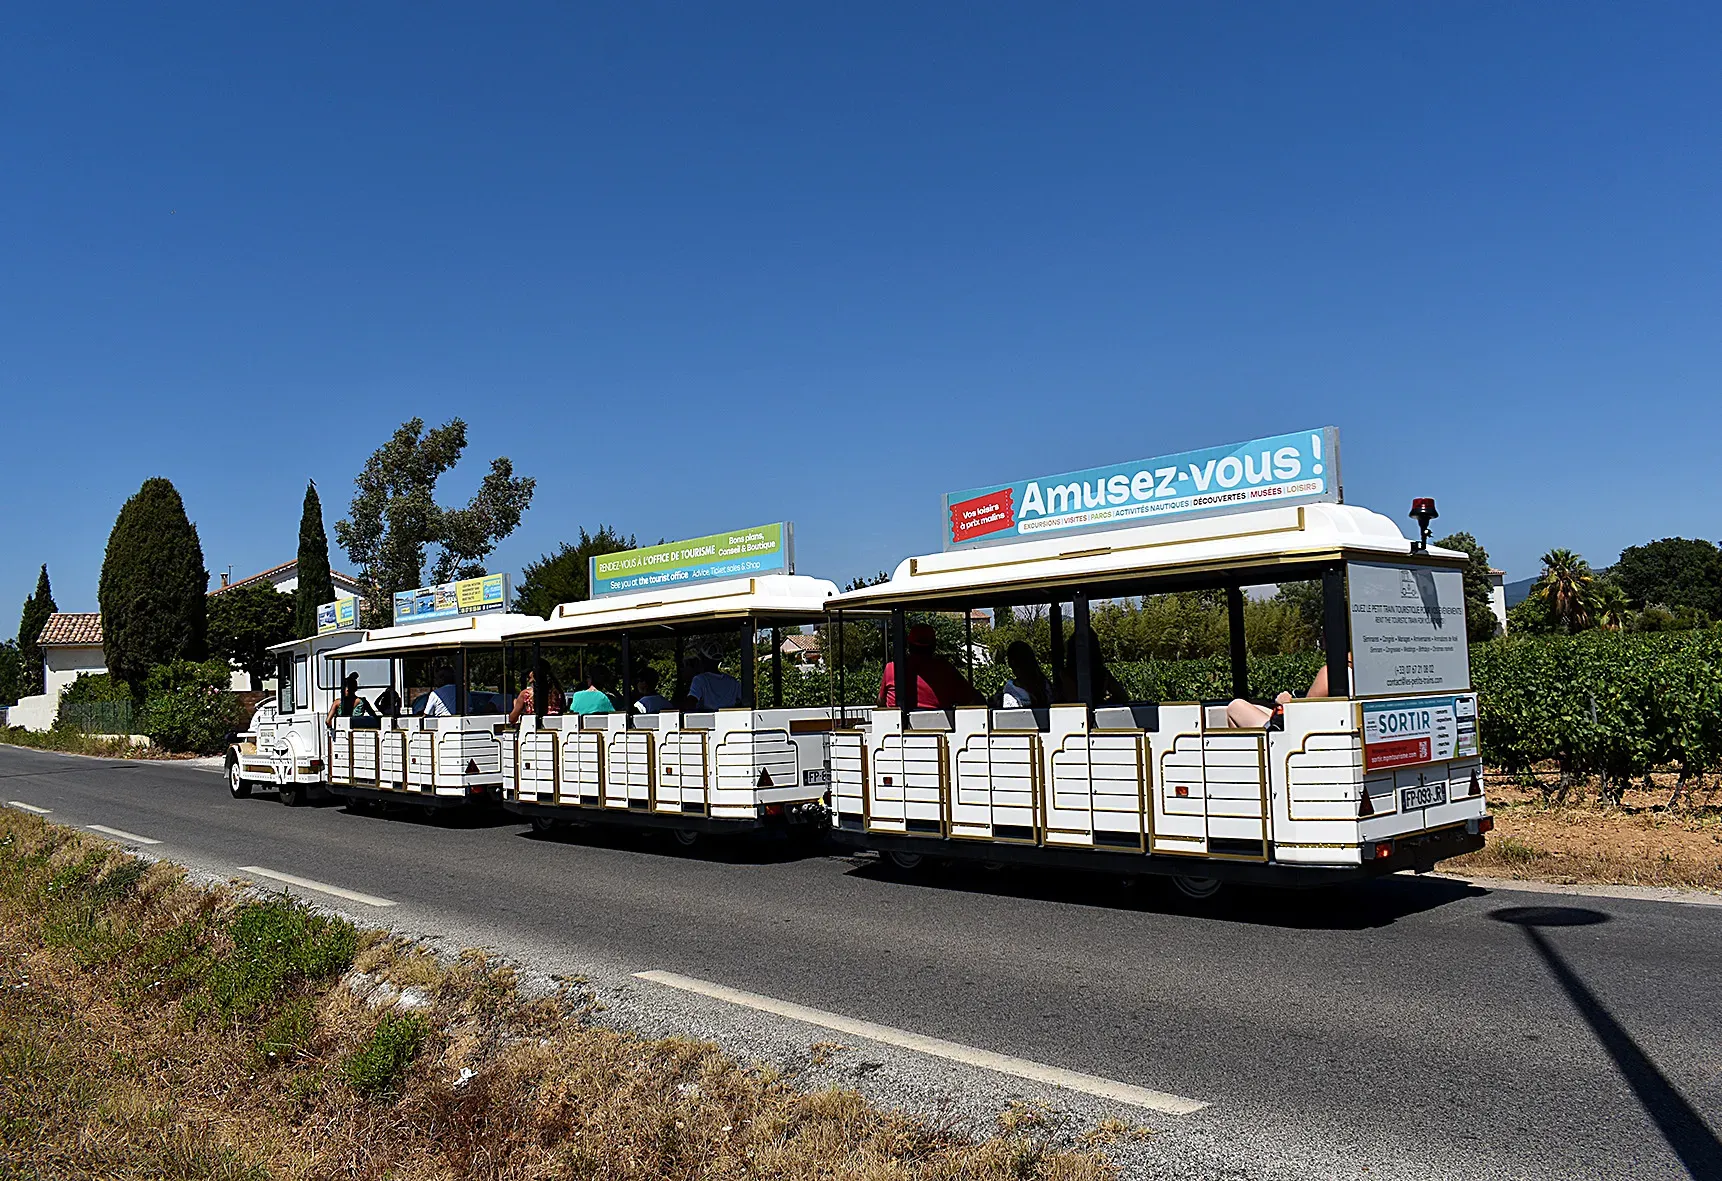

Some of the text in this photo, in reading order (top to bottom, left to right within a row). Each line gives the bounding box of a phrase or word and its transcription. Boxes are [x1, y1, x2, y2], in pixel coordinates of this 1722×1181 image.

[1018, 434, 1323, 518] Amusez-vous !
[962, 503, 1000, 520] Vos loisirs
[1023, 482, 1317, 530] EXCURSIONS VISITES PARCS ACTIVITÉS NAUTIQUES DÉCOUVERTES MUSÉES LOISIRS
[960, 511, 1006, 530] à prix malins
[718, 540, 776, 556] Conseil & Boutique
[728, 532, 764, 545] Bons plans,
[599, 557, 637, 573] RENDEZ-VOUS
[643, 552, 669, 566] L'OFFICE
[671, 551, 680, 562] DE
[681, 544, 716, 560] TOURISME
[610, 580, 621, 590] See
[621, 580, 631, 590] you
[631, 578, 638, 587] at
[638, 577, 649, 586] the
[649, 573, 670, 584] tourist
[670, 570, 689, 581] office
[710, 566, 727, 575] Ticket
[726, 563, 740, 573] sales
[740, 562, 746, 571] &
[746, 561, 761, 570] Shop
[1379, 710, 1431, 734] SORTIR
[1406, 785, 1442, 808] FP-093-JR
